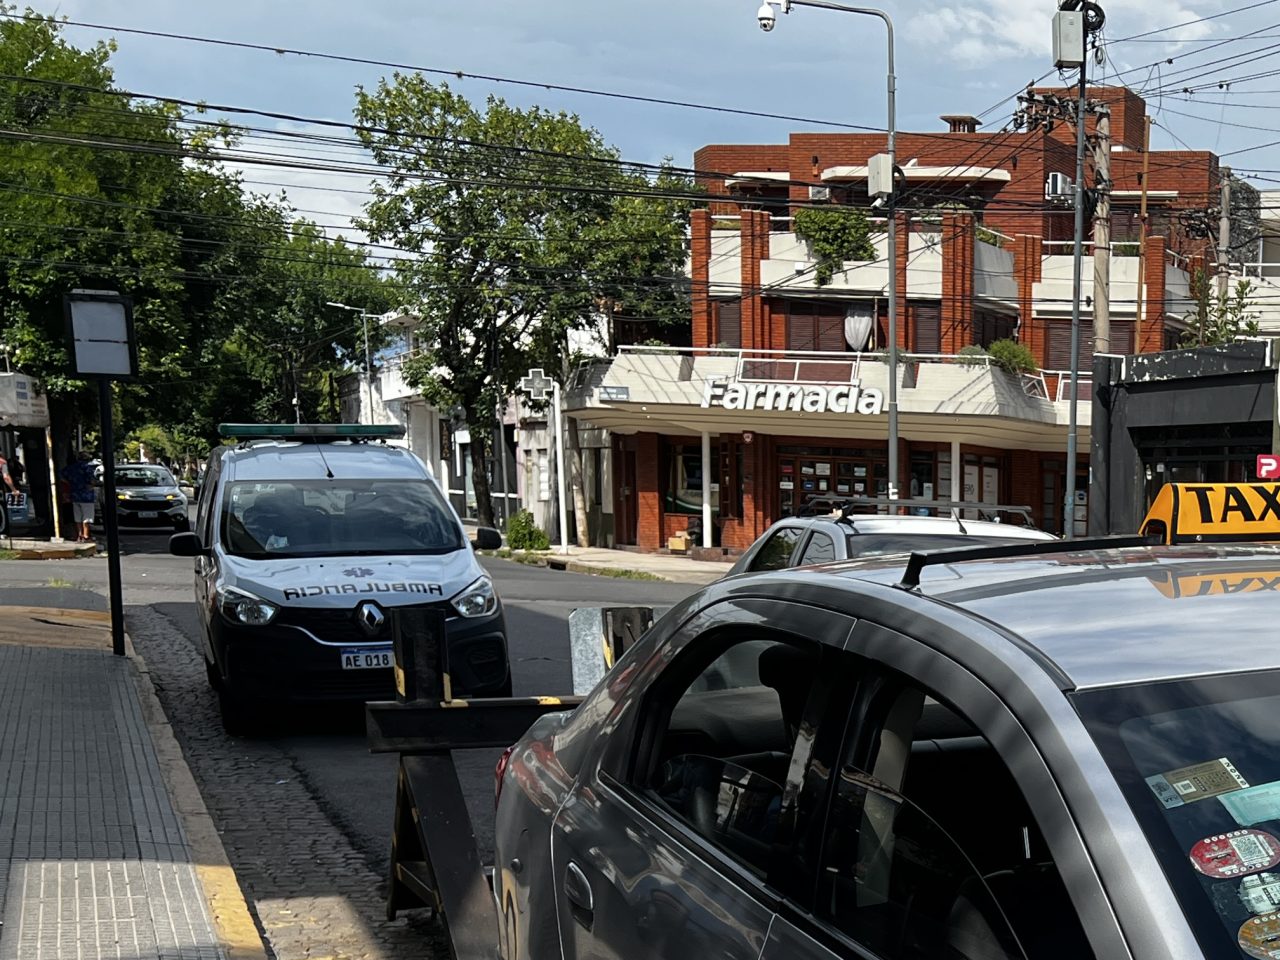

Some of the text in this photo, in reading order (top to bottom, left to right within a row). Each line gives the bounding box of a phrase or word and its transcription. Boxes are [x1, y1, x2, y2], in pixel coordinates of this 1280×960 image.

[701, 376, 884, 415] Farmacia
[345, 653, 390, 668] AE 018
